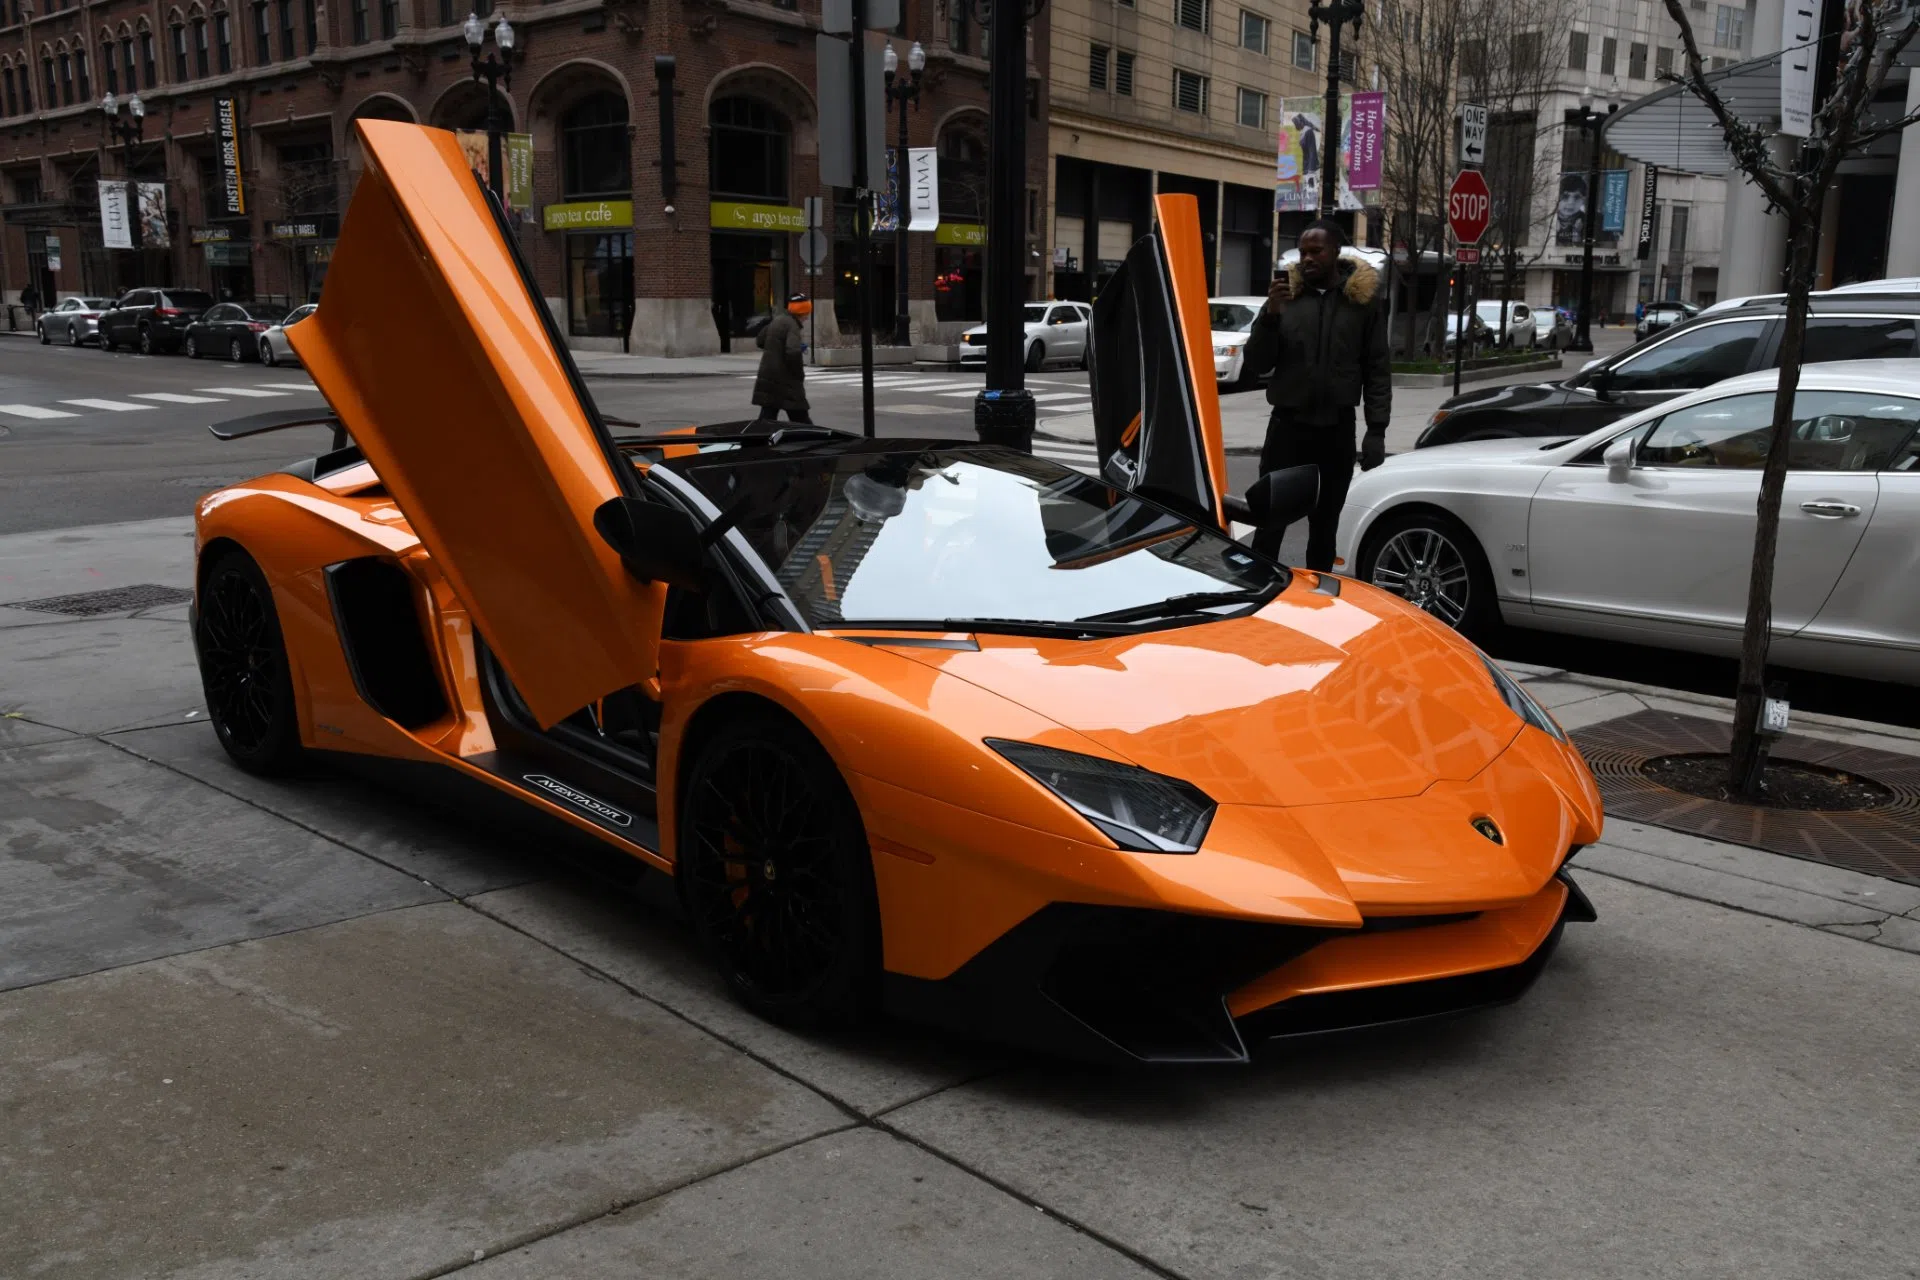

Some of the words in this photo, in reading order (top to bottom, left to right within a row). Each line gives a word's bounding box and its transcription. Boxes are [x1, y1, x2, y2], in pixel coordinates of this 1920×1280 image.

[1793, 0, 1814, 72] LU
[219, 100, 234, 137] BAGELS
[1353, 110, 1365, 126] My
[1367, 110, 1377, 130] Her
[1465, 109, 1484, 125] ONE
[1465, 127, 1485, 141] WAY
[1353, 131, 1365, 171] Dreams
[520, 148, 529, 187] Everyday
[226, 169, 240, 212] EINSTEIN
[917, 153, 931, 211] LUMA
[1644, 166, 1655, 217] ORDSTROM
[1284, 191, 1310, 201] LUMA
[1451, 193, 1488, 221] STOP
[567, 209, 582, 222] tea
[584, 203, 612, 222] café
[752, 212, 777, 228] argo
[778, 212, 791, 225] tea
[1640, 220, 1651, 243] rack
[1467, 251, 1477, 262] WAY
[537, 779, 621, 819] AVENTADOR
